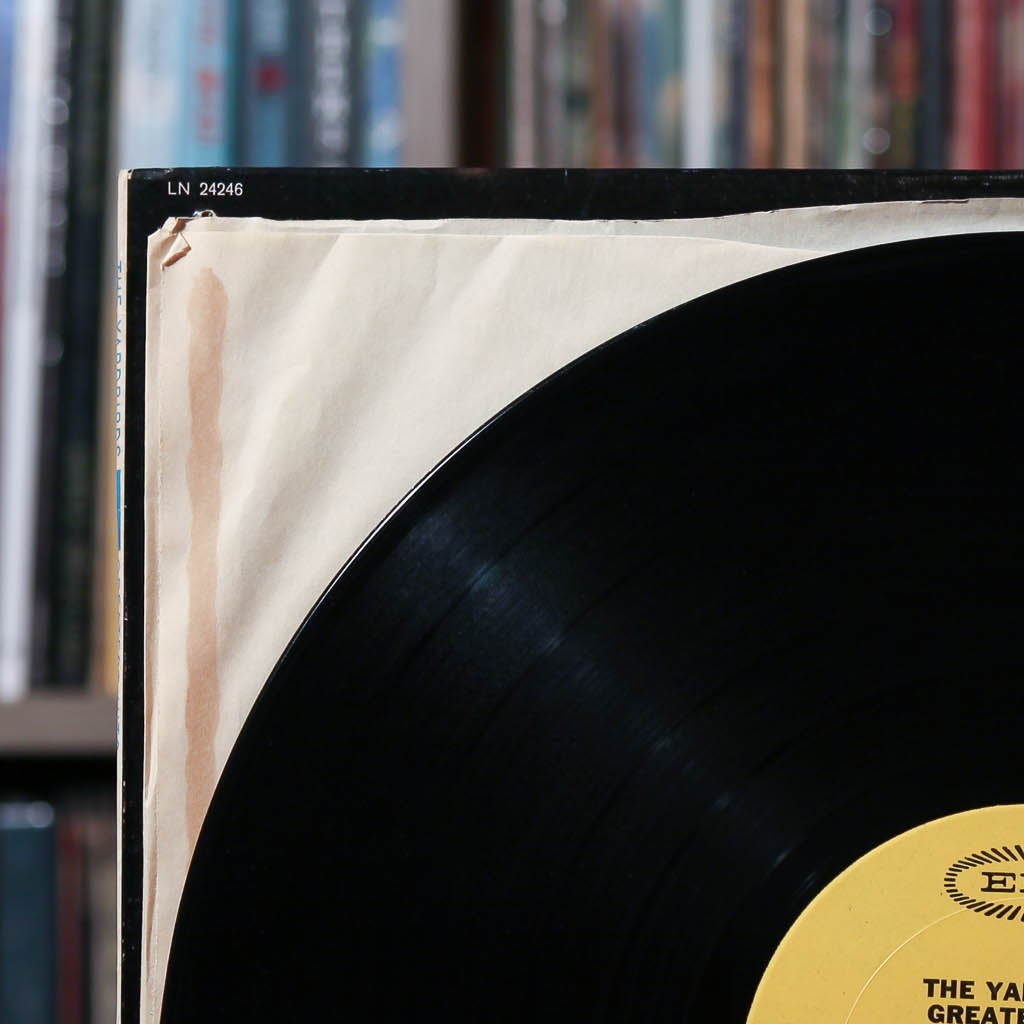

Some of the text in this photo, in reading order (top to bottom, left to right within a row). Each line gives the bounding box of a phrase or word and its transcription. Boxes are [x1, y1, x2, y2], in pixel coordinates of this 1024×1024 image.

[167, 180, 244, 197] LN 24246
[922, 978, 975, 1000] THE
